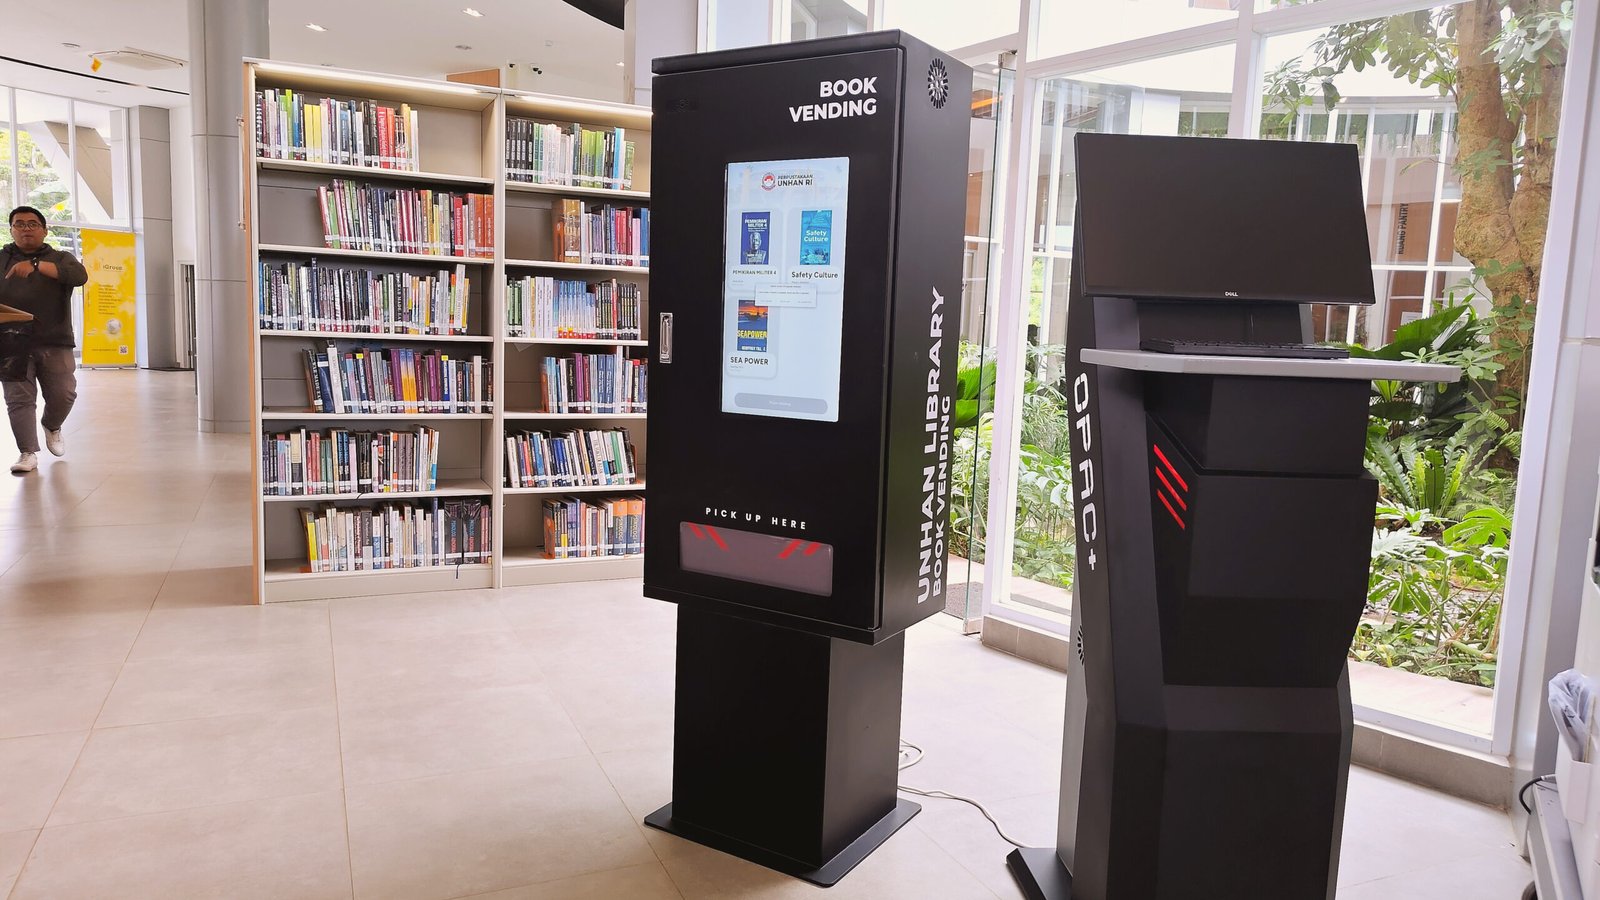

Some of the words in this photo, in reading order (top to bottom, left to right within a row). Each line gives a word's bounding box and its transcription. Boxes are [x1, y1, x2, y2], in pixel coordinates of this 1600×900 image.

[819, 76, 877, 98] BOOK
[788, 98, 877, 123] VENDING
[1399, 203, 1409, 230] PANTRY
[806, 229, 827, 237] Safety
[791, 271, 813, 279] Safety
[736, 330, 768, 339] SEAPOWER
[730, 356, 743, 364] SEA
[744, 357, 769, 365] POWER
[924, 286, 945, 454] LIBRARY
[936, 395, 951, 516] VENDING
[1073, 372, 1097, 571] OPAC+
[705, 507, 737, 519] PICK
[745, 513, 761, 523] UP
[771, 517, 806, 530] HERE
[917, 466, 935, 604] UNHAN
[931, 520, 945, 597] BOOK
